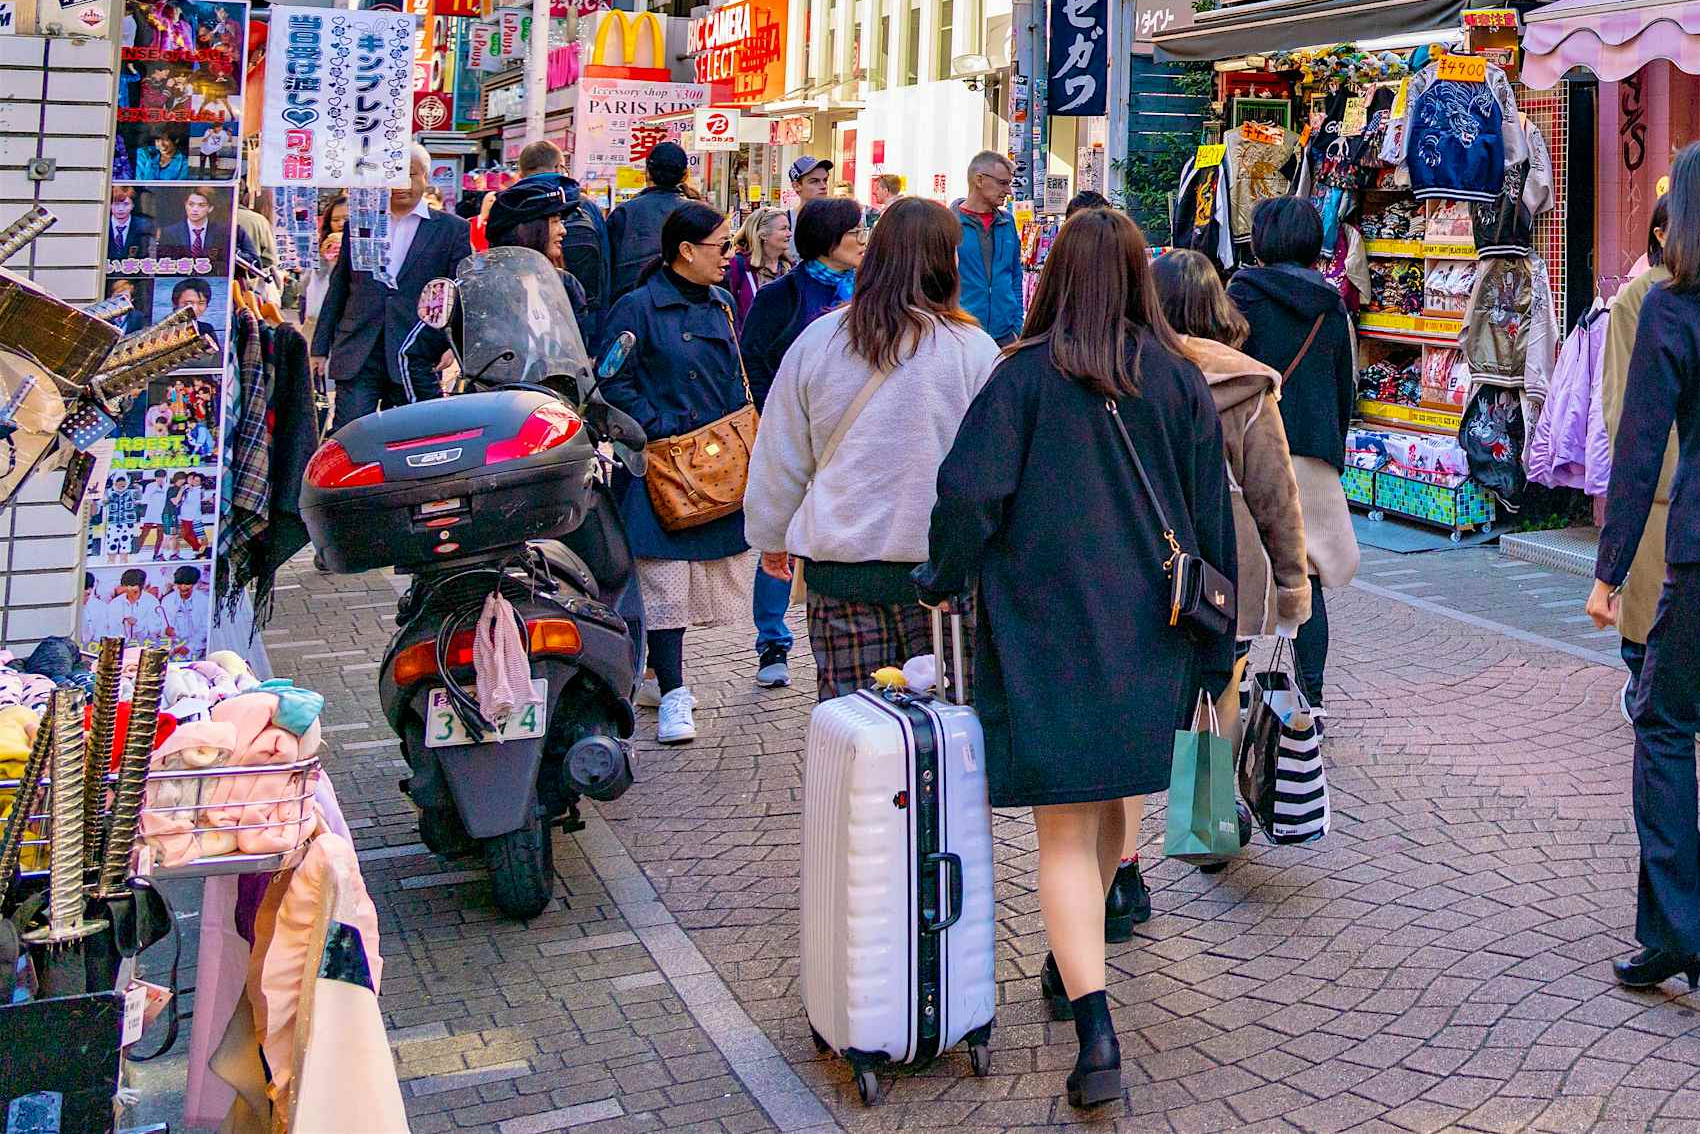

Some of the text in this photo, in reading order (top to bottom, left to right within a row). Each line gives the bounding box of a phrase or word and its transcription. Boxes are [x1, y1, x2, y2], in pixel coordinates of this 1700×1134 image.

[704, 2, 752, 49] CAMERA
[693, 46, 736, 84] SELECT
[1439, 58, 1485, 77] ¥4900
[644, 87, 668, 100] shop
[589, 100, 647, 115] PARIS
[105, 257, 212, 275] いまを生きる
